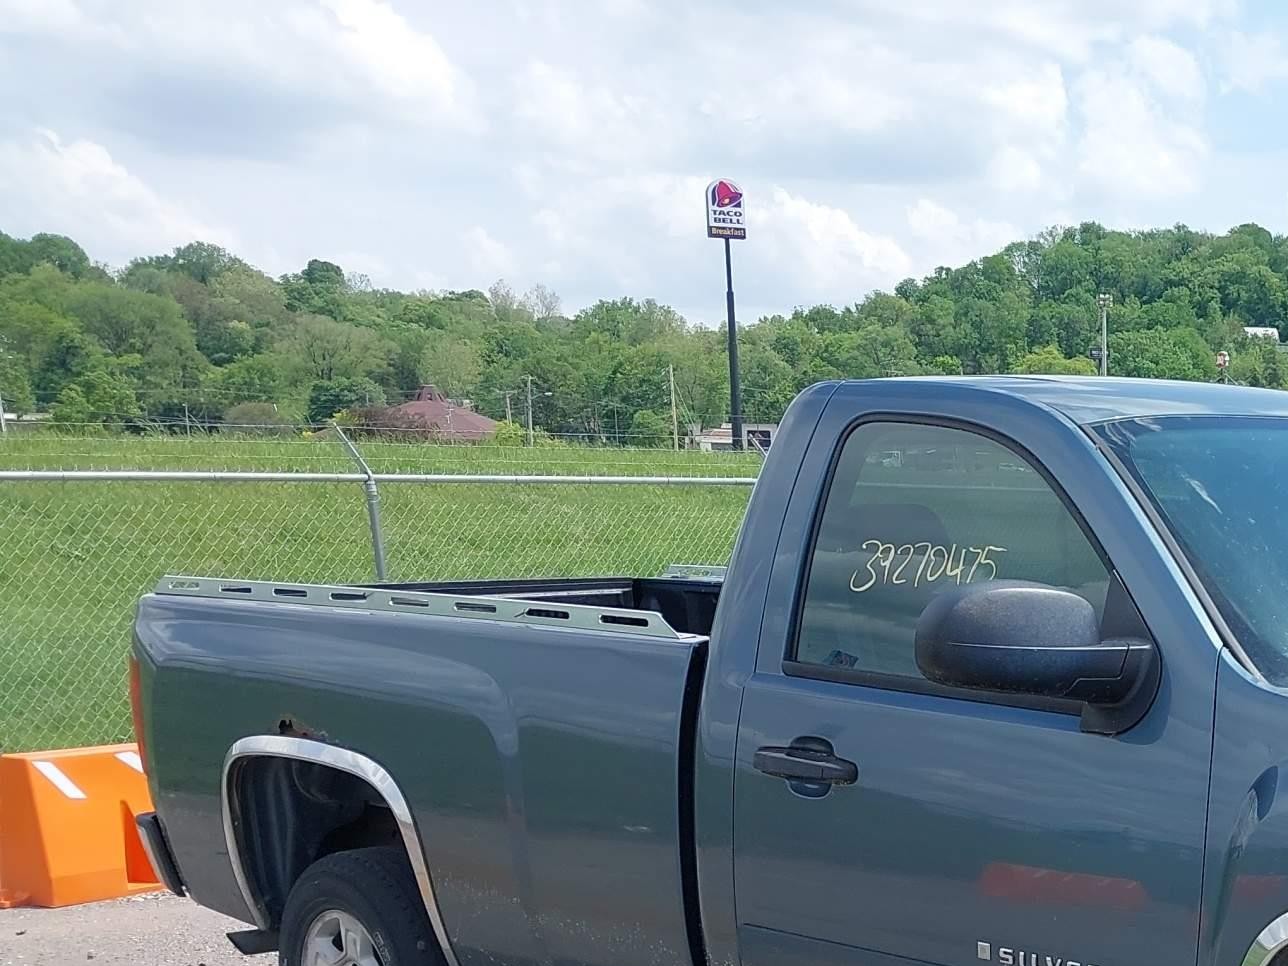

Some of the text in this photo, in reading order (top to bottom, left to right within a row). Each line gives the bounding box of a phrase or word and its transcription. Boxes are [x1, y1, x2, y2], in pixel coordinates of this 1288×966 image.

[711, 209, 743, 217] TACO
[713, 217, 743, 225] BELL
[711, 227, 745, 236] Breakfast
[850, 539, 1007, 592] 39270475
